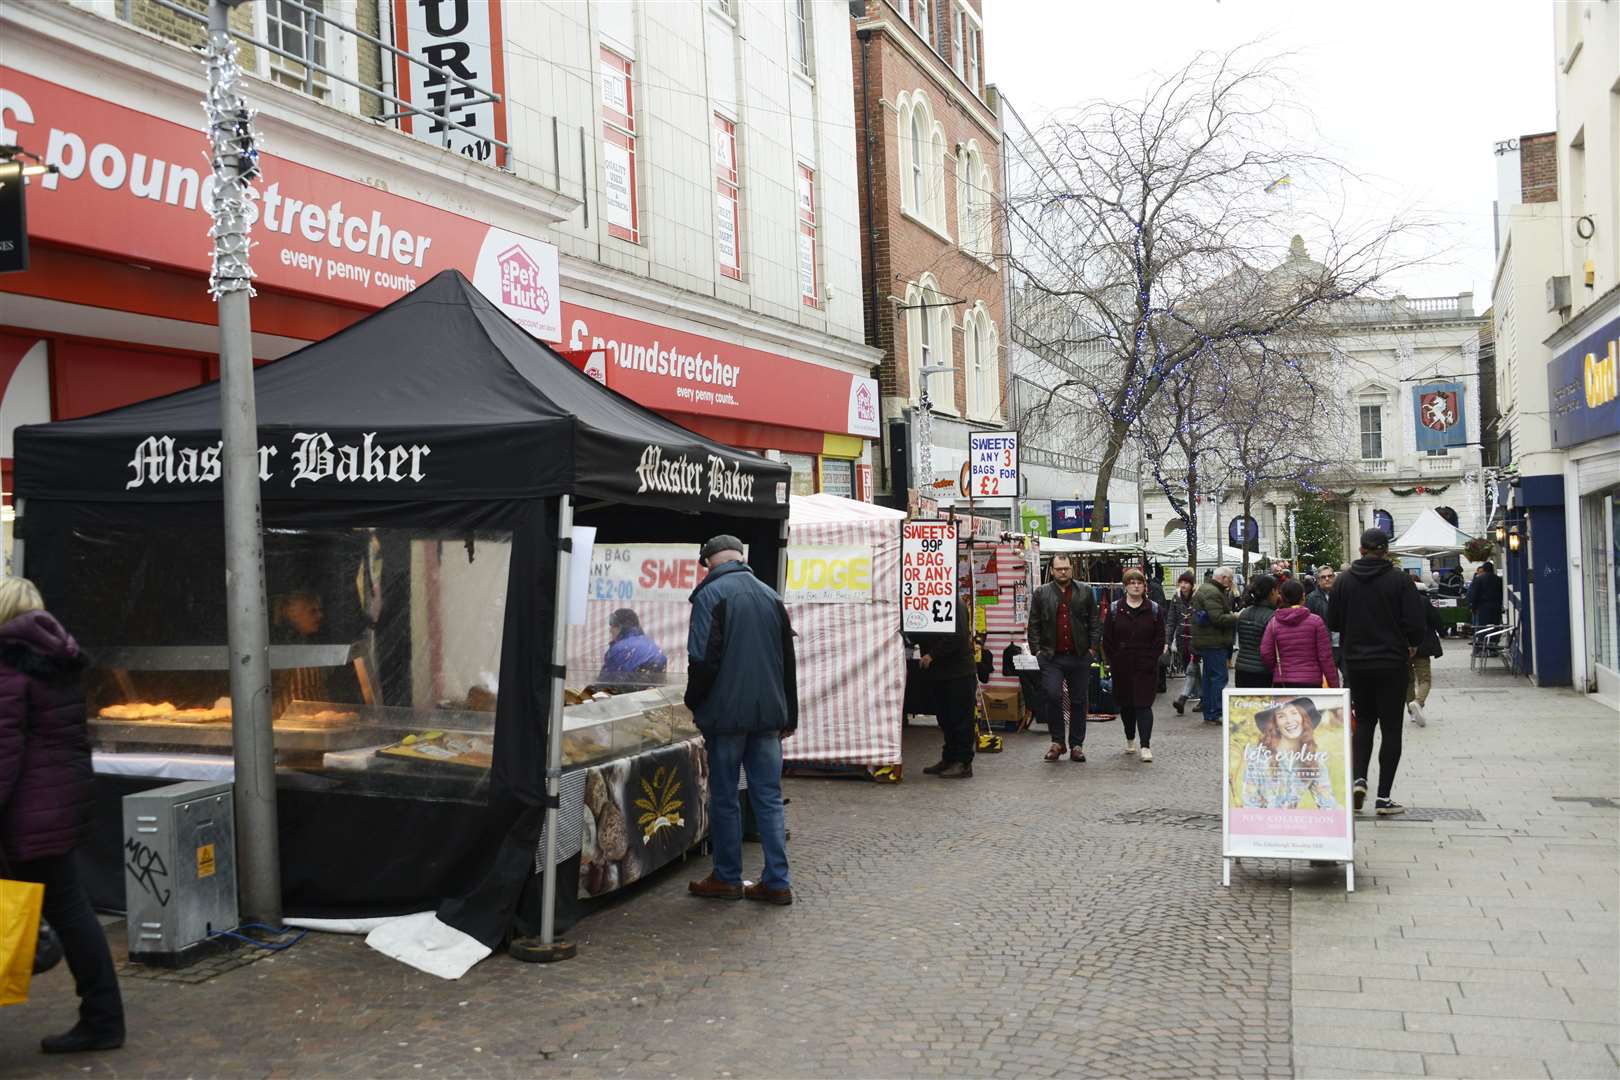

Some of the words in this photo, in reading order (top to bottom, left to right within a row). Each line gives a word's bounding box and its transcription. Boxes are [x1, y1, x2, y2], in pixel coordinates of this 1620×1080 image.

[280, 248, 323, 278] every
[327, 257, 370, 288] penny
[510, 259, 536, 288] Pet
[510, 282, 537, 309] Hut
[676, 387, 694, 402] every
[695, 390, 715, 405] penny
[972, 438, 1015, 450] SWEETS
[126, 435, 278, 490] Masr
[291, 431, 431, 488] Baker
[980, 452, 999, 462] ANY
[1003, 449, 1012, 468] 3
[636, 444, 703, 496] Master
[707, 454, 754, 503] Baker
[972, 465, 995, 475] BAGS
[1000, 468, 1016, 479] FOR
[863, 471, 872, 504] FU
[980, 475, 999, 495] £2
[903, 525, 955, 539] SWEETS
[604, 549, 631, 561] BAG
[904, 552, 912, 566] A
[916, 552, 944, 566] BAG
[904, 567, 920, 581] OR
[924, 567, 953, 581] ANY
[904, 582, 912, 596] 3
[917, 582, 953, 596] BAGS
[904, 596, 929, 610] FOR
[932, 599, 953, 623] £2
[1275, 743, 1328, 772] explore
